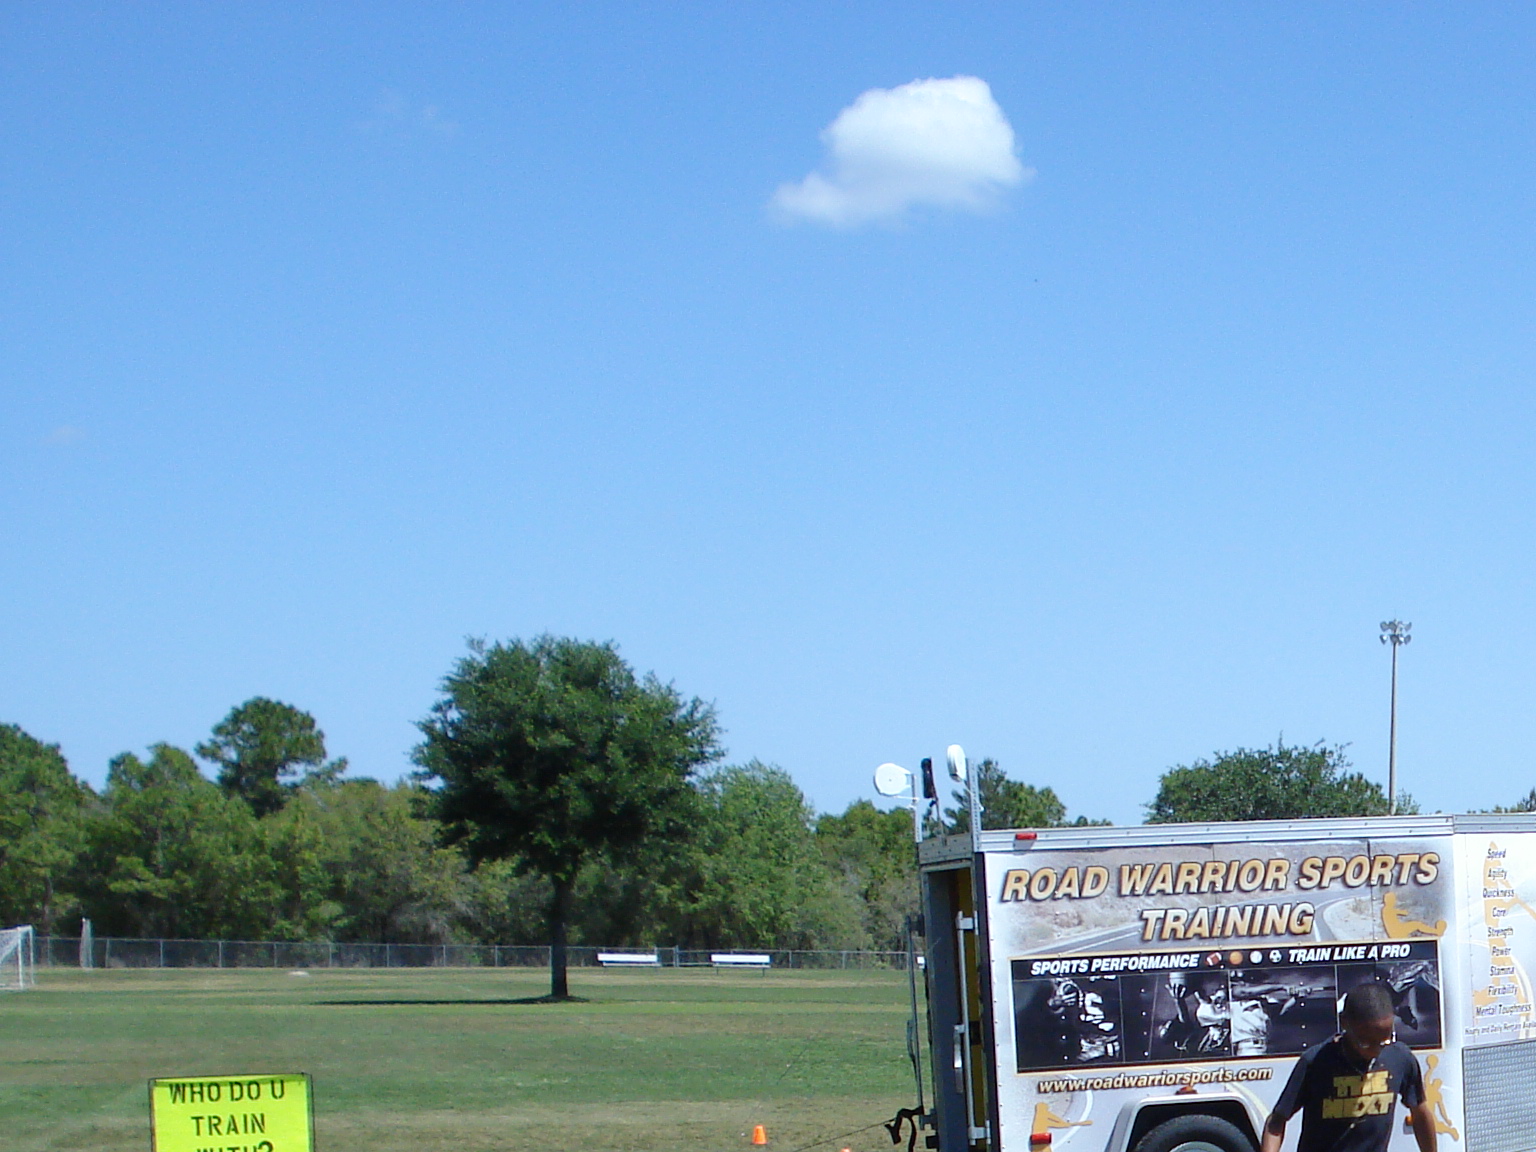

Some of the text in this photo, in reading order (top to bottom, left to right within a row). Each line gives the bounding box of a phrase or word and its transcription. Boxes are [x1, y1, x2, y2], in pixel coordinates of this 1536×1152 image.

[1487, 848, 1506, 860] Speed
[1000, 852, 1441, 903] ROAD WARRIOR SPORTS
[1488, 867, 1508, 880] Agility
[1483, 887, 1514, 898] Quickness
[1492, 906, 1507, 917] Core
[1140, 902, 1315, 943] TRAINING
[1487, 926, 1514, 938] Strength
[1288, 943, 1411, 963] TRAIN LIKE A PRO
[1031, 953, 1200, 976] SPORTS PERFORMANCE
[1489, 965, 1515, 977] Stamina
[1487, 985, 1518, 996] Flexibility
[1038, 1065, 1274, 1094] www.roadwarriorsports.com
[1333, 1070, 1389, 1097] THE
[169, 1079, 285, 1104] WHO DO U
[1322, 1092, 1394, 1119] NEXT
[191, 1112, 265, 1137] TRAIN
